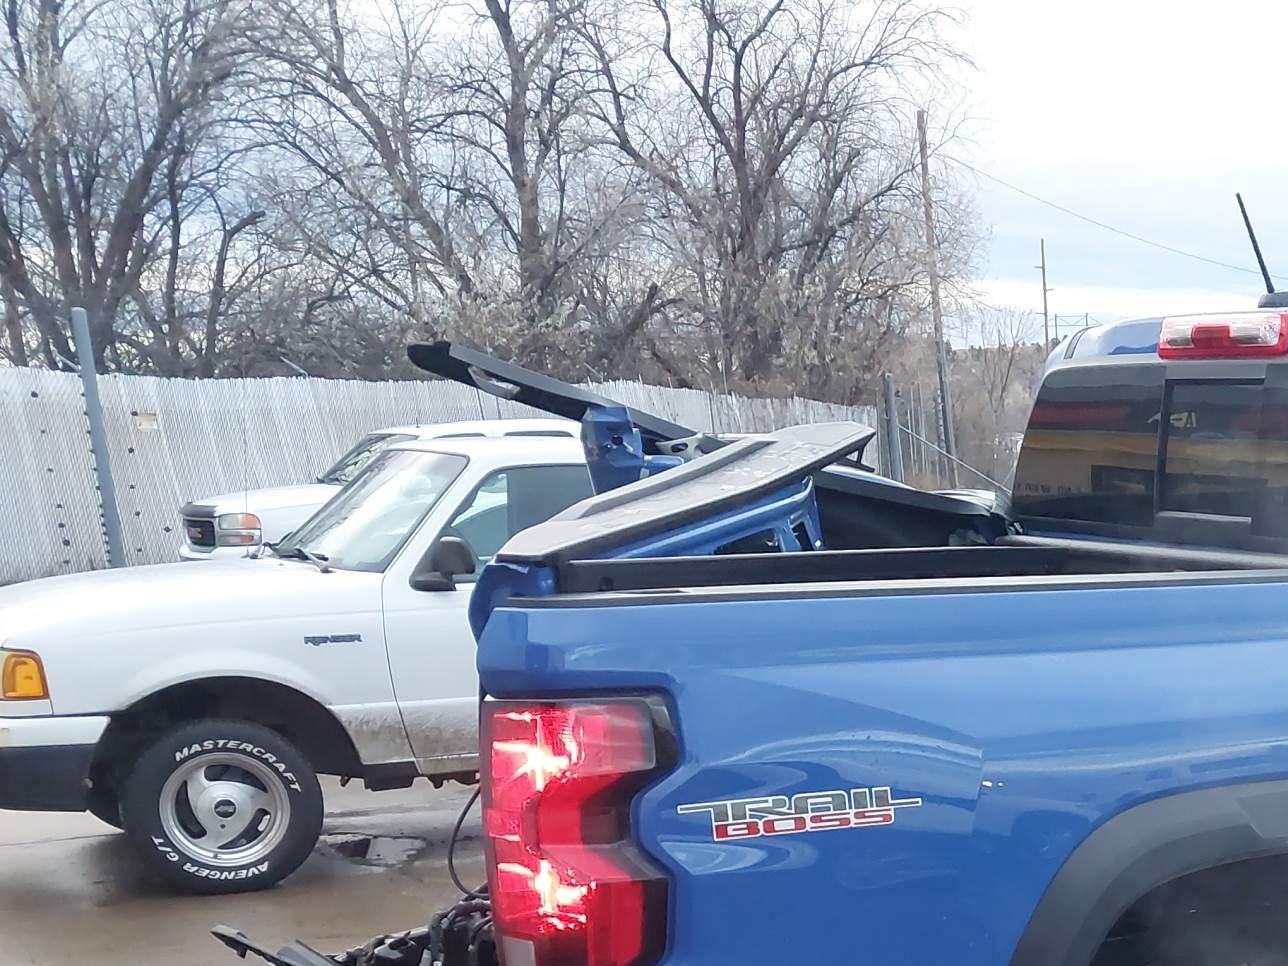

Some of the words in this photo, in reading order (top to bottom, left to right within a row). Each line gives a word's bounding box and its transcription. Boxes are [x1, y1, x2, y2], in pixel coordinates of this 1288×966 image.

[174, 739, 302, 794] MASTERCRAFT
[676, 786, 922, 826] TRAIL
[713, 807, 895, 842] BOSS
[182, 860, 270, 880] AVENGER
